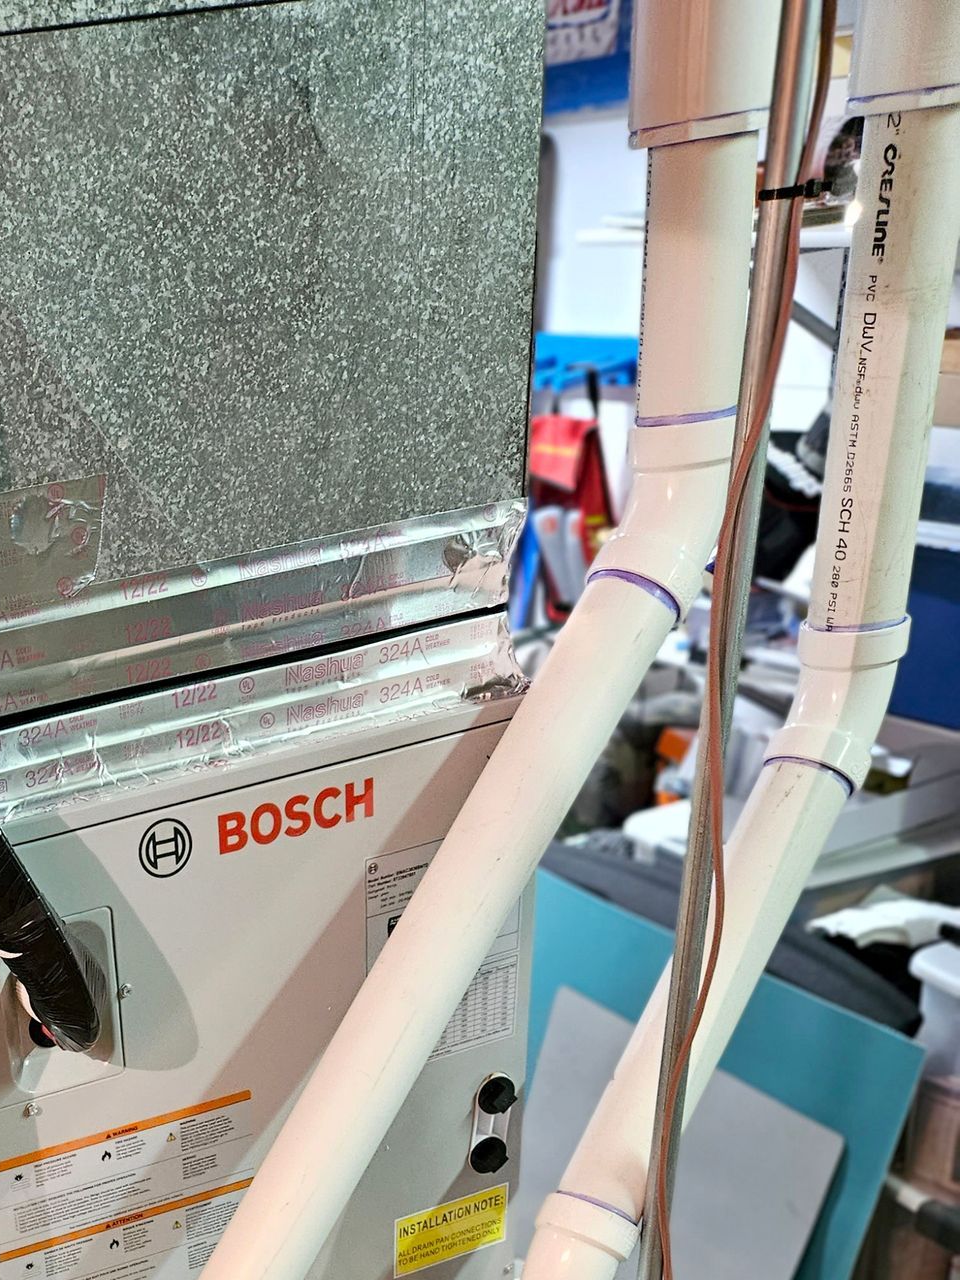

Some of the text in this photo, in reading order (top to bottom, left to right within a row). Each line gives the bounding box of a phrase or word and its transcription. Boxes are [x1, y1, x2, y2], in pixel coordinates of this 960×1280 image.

[870, 142, 899, 257] CRESLINE
[865, 275, 878, 302] PVC
[861, 312, 876, 353] DWV
[848, 414, 860, 448] ASTM
[842, 451, 855, 492] D2665
[838, 498, 854, 534] SCH
[834, 537, 847, 561] 40
[830, 565, 841, 587] 280
[826, 592, 838, 613] PSI
[19, 719, 69, 747] 324A
[172, 681, 218, 709] 12/22
[285, 653, 364, 687] Nashua
[379, 637, 423, 665] 324A
[177, 720, 222, 749] 12/22
[286, 692, 364, 726] Nashua
[380, 677, 424, 704] 324A
[217, 777, 374, 855] BOSCH
[111, 1212, 144, 1227] ATTENTION
[399, 1195, 504, 1239] INSTALLATION NOTE:
[398, 1217, 502, 1258] ALL DRAIN PAN CONNECTIONS
[398, 1227, 500, 1267] TO BE HAND TIGHTENED ONLY
